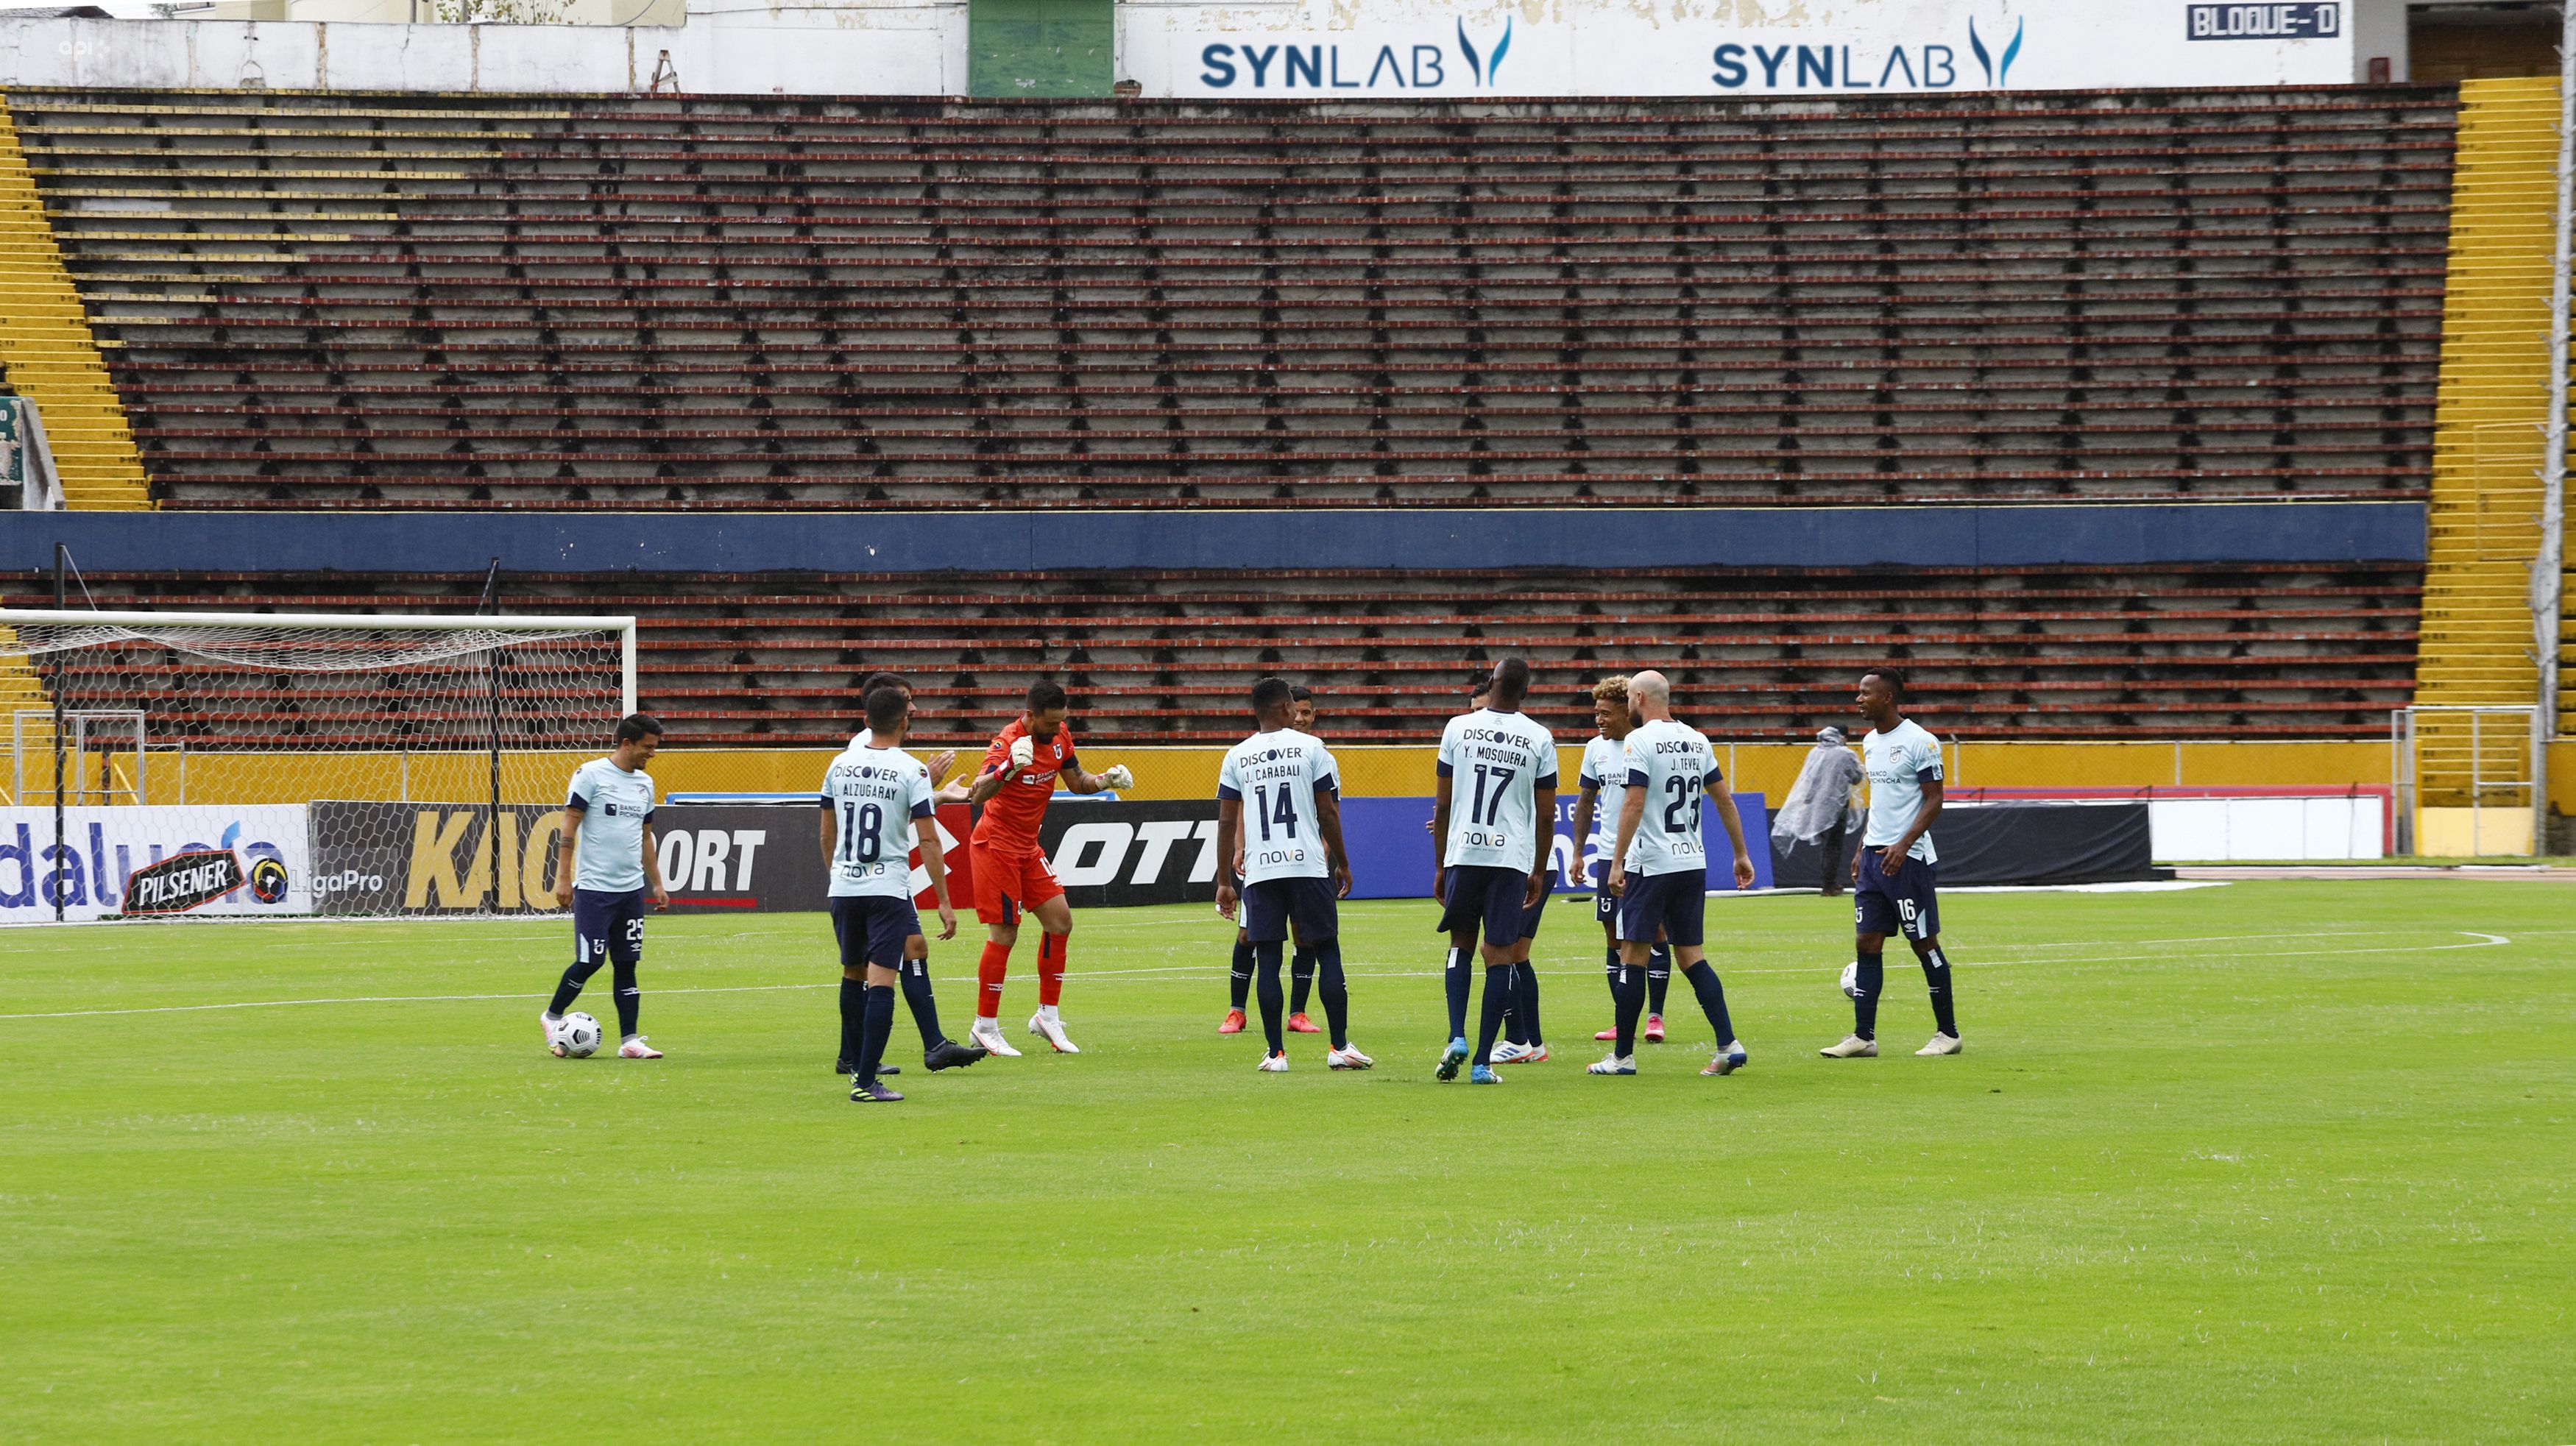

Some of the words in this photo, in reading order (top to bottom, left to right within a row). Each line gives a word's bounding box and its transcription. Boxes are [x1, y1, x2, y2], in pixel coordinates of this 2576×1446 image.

[1200, 43, 1445, 88] SYNLAB
[1711, 43, 1956, 88] SYNLAB
[1463, 728, 1531, 750] DISCOVER
[1239, 747, 1302, 769] DISCOVER
[1464, 745, 1473, 758] Y.
[1476, 745, 1527, 768] MOSQUERA
[1671, 758, 1679, 770] J.
[1680, 758, 1700, 770] TEVEZ
[835, 765, 899, 783] DISCOVER
[1245, 771, 1253, 784] J.
[1255, 765, 1300, 781] CARABALI
[843, 783, 898, 801] ALZUGARAY
[1471, 764, 1515, 827] 17
[1254, 782, 1298, 842] 14
[1665, 775, 1702, 833] 23
[843, 801, 883, 864] 18
[1460, 831, 1506, 847] nova
[651, 829, 766, 893] ORT
[1259, 848, 1305, 865] nova
[840, 862, 885, 879] nova
[138, 859, 228, 907] PILSENER
[291, 869, 383, 899] LigaPro
[1897, 898, 1917, 921] 16
[626, 918, 645, 940] 25
